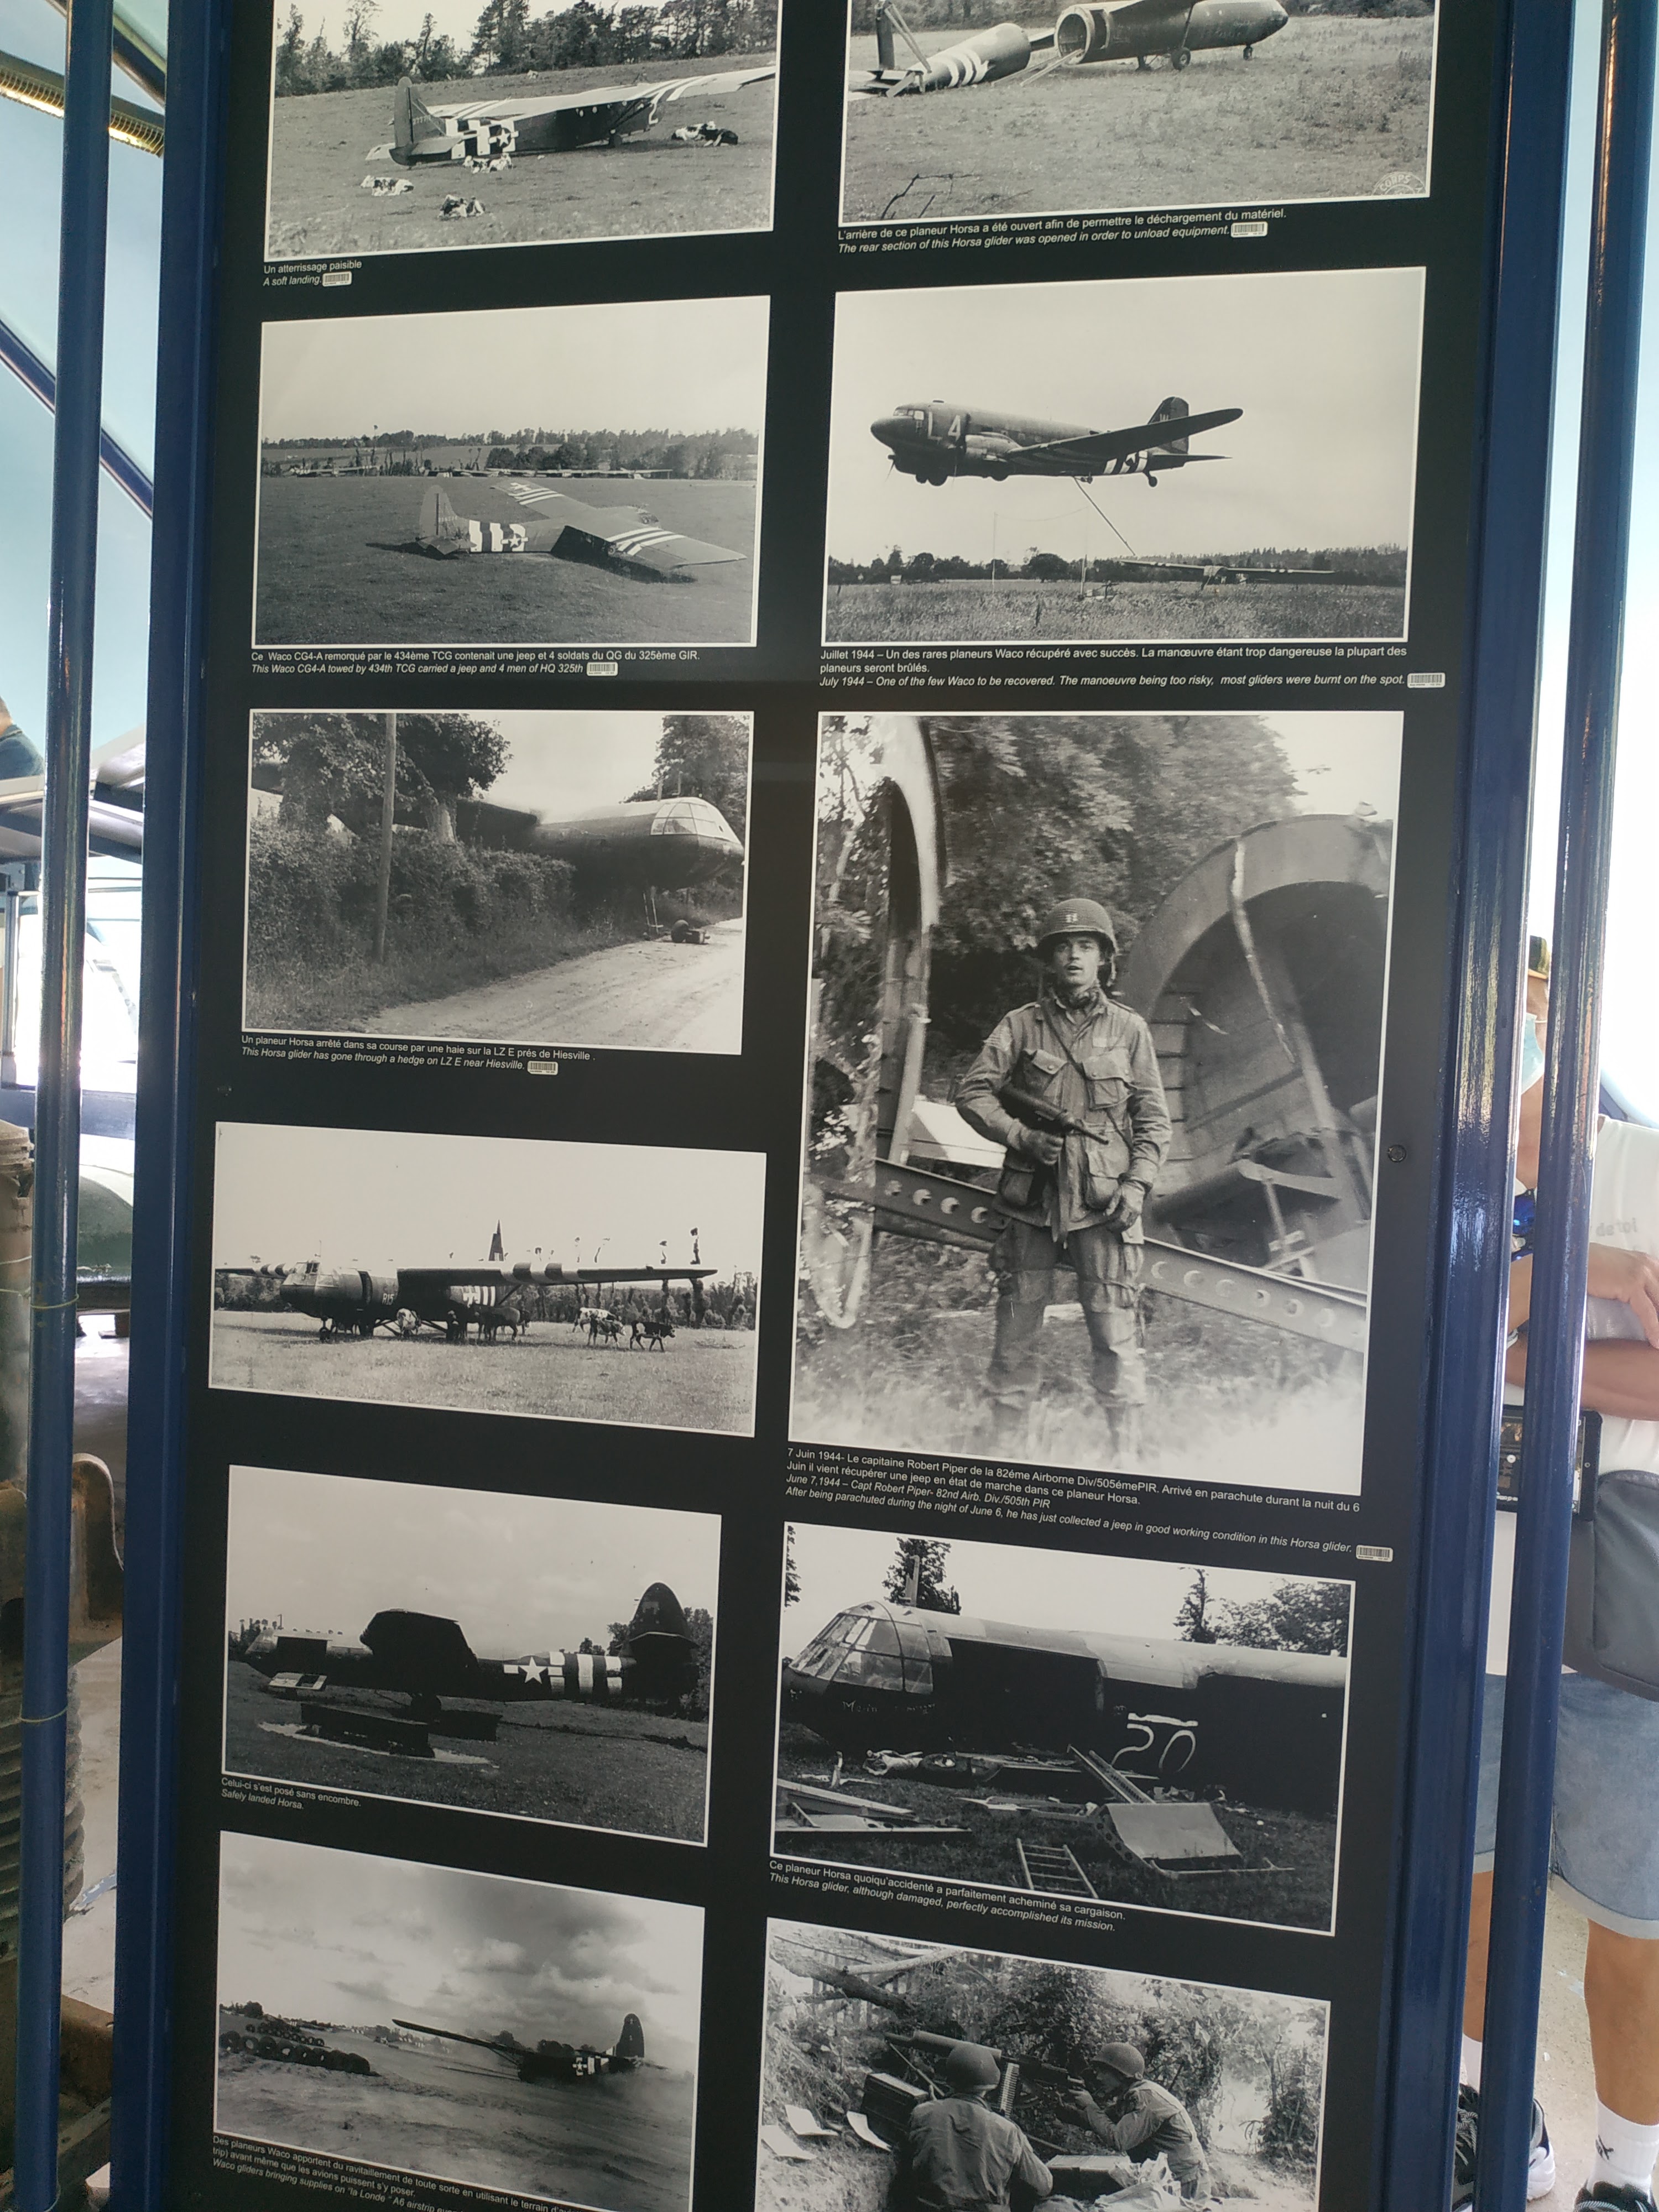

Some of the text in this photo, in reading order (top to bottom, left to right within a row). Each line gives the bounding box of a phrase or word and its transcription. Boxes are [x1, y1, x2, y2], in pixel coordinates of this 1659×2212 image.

[1379, 174, 1411, 191] CORPS
[839, 225, 1229, 253] The rear section of this Horsa glider was opened in order to unload equipment.
[264, 259, 362, 274] Un atterrissage paisible
[272, 277, 288, 286] soft
[289, 275, 322, 286] landing.
[251, 651, 264, 661] Ce
[268, 651, 292, 661] Waco
[294, 651, 324, 661] CG4-A
[325, 651, 365, 662] remorqué
[367, 653, 383, 662] par
[384, 651, 392, 660] le
[394, 651, 430, 660] 434ème
[431, 651, 452, 660] TCG
[455, 651, 495, 660] contenait
[515, 651, 536, 662] jeep
[538, 651, 547, 660] et
[549, 650, 555, 660] 4
[557, 650, 590, 660] soldats
[592, 650, 604, 660] du
[606, 650, 622, 660] QG
[624, 650, 637, 660] du
[639, 651, 676, 660] 325ème
[679, 650, 700, 660] GIR.
[820, 650, 848, 660] Juillet
[852, 649, 875, 659] 1944
[886, 649, 900, 659] Un
[902, 649, 920, 659] des
[922, 651, 948, 659] rares
[950, 649, 993, 661] planeurs
[995, 648, 1024, 659] Waco
[1026, 648, 1071, 660] récupéré
[1073, 650, 1098, 658] avec
[1100, 648, 1139, 658] succès.
[1141, 648, 1155, 658] La
[1216, 646, 1243, 657] étant
[1245, 647, 1266, 659] trop
[1269, 646, 1332, 659] dangereuse
[1334, 646, 1344, 656] la
[1347, 646, 1385, 658] plupart
[1387, 646, 1407, 656] des
[820, 662, 930, 675] planeurs seront brûlés.
[242, 1035, 253, 1044] Un
[255, 1036, 287, 1046] planeur
[289, 1037, 314, 1047] Horsa
[316, 1039, 341, 1048] arrêté
[343, 1040, 364, 1049] dans
[379, 1043, 408, 1051] course
[410, 1045, 425, 1053] par
[446, 1045, 465, 1054] haie
[483, 1046, 491, 1055] la
[494, 1047, 506, 1056] LZ
[508, 1047, 514, 1057] E
[539, 1049, 551, 1058] de
[553, 1050, 590, 1060] Hiesville
[788, 1447, 794, 1457] 7
[796, 1449, 815, 1459] Juin
[818, 1451, 845, 1462] 1944-
[847, 1453, 859, 1463] Le
[862, 1456, 905, 1468] capitaine
[907, 1459, 940, 1472] Robert
[942, 1462, 968, 1475] Piper
[970, 1465, 983, 1475] de
[985, 1467, 994, 1477] la
[1032, 1472, 1074, 1485] Airborne
[1161, 1484, 1192, 1496] Arrivé
[1194, 1489, 1208, 1498] en
[1211, 1491, 1263, 1503] parachute
[1265, 1494, 1300, 1507] durant
[1302, 1498, 1312, 1507] la
[1314, 1500, 1334, 1510] nuit
[1336, 1501, 1350, 1511] du
[1353, 1503, 1360, 1512] 6
[786, 1473, 808, 1484] June
[851, 1479, 873, 1492] Capt
[874, 1481, 905, 1494] Robert
[936, 1488, 959, 1499] 82nd
[960, 1491, 981, 1501] Airb.
[1032, 1498, 1051, 1509] PIR
[221, 1788, 304, 1809] Safely landed Horsa.
[274, 1787, 294, 1796] posé
[296, 1790, 316, 1800] sans
[318, 1793, 362, 1807] encombre.
[770, 1872, 1115, 1931] This Horsa glider, although damaged, perfectly accomplished its mission.
[213, 2135, 229, 2146] Des
[231, 2140, 265, 2154] planeurs
[267, 2147, 290, 2159] Waco
[293, 2153, 331, 2168] apportent
[333, 2161, 343, 2170] du
[346, 2163, 400, 2182] ravitaillement
[402, 2176, 413, 2185] de
[415, 2178, 436, 2190] toute
[439, 2184, 460, 2195] sorte
[476, 2192, 508, 2205] utilisant
[510, 2197, 519, 2207] le
[521, 2200, 549, 2212] terrain
